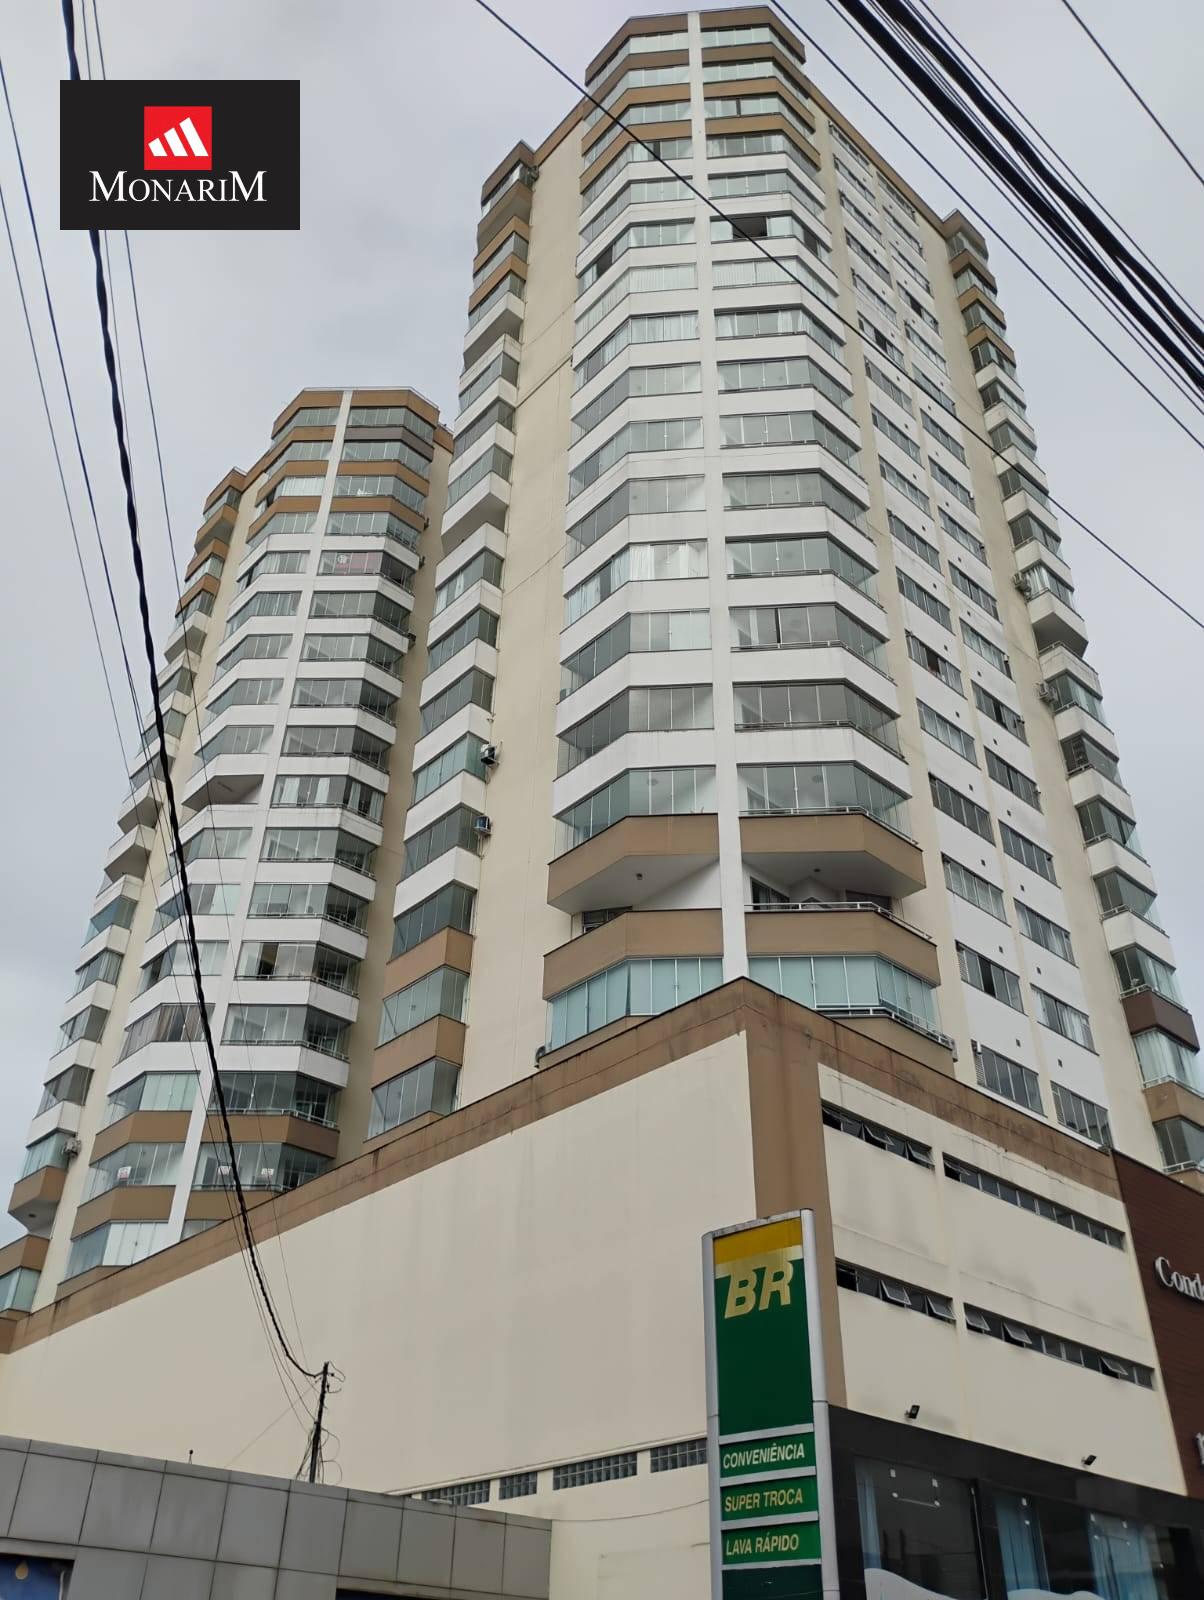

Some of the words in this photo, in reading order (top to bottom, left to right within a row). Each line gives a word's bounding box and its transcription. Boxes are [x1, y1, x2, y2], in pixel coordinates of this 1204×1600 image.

[724, 1260, 794, 1319] BR
[723, 1443, 805, 1469] CONVENIÊNCIA
[724, 1493, 761, 1513] SUPER
[763, 1488, 804, 1508] TROCA
[726, 1537, 753, 1556] LAVA
[755, 1532, 799, 1553] RÁPIDO
